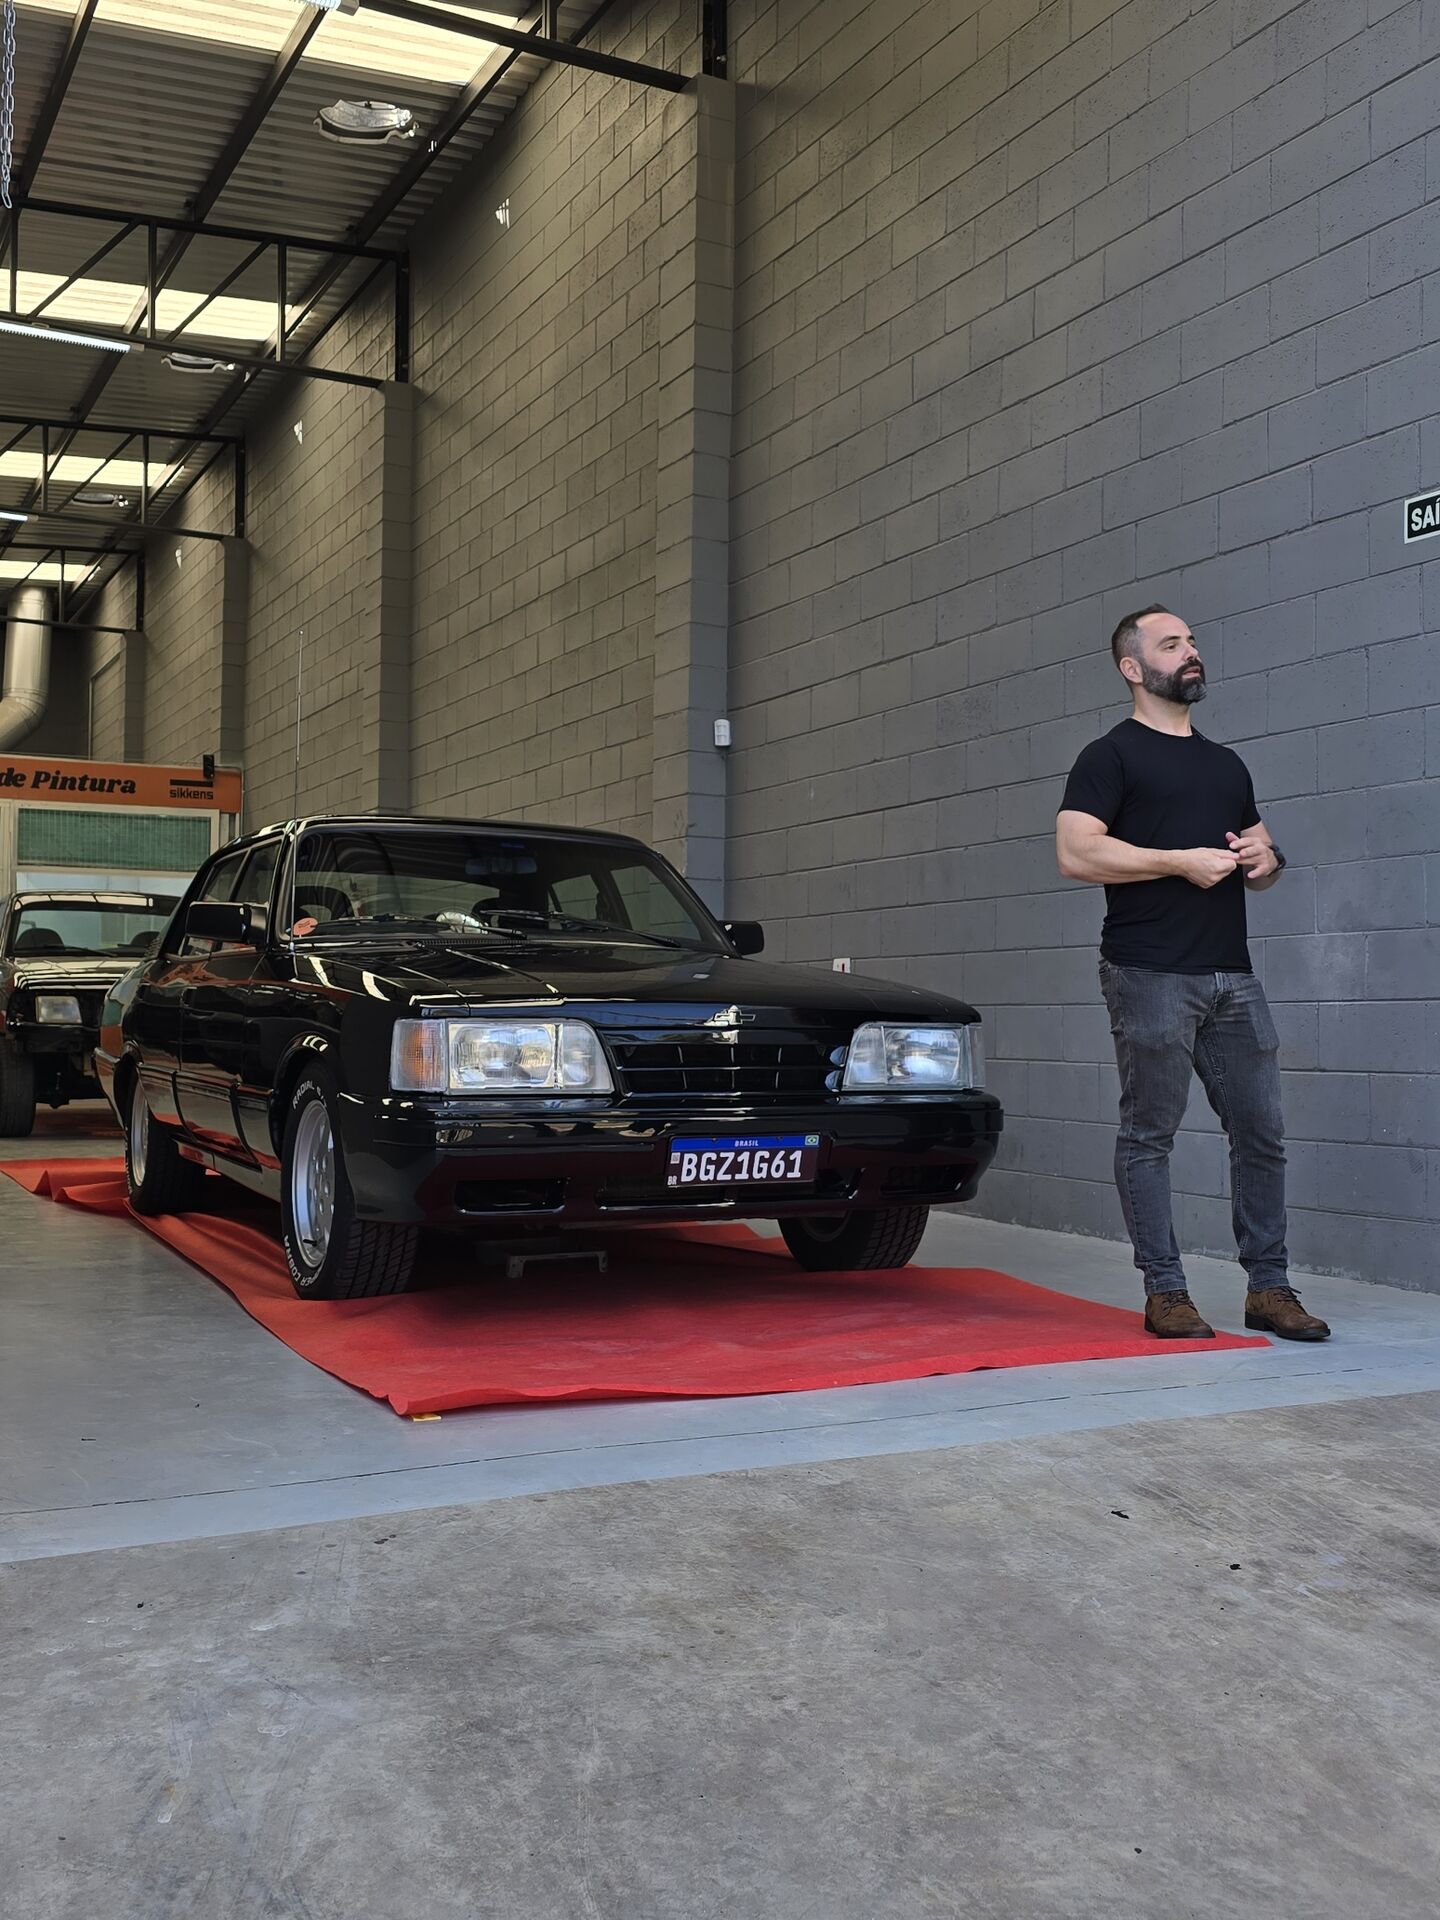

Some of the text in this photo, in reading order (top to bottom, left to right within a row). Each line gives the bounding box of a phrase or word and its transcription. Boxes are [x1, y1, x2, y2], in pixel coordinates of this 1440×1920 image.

[0, 767, 136, 794] de Pintura
[169, 787, 213, 800] sikkens
[292, 1080, 315, 1110] RADIAL
[734, 1139, 759, 1147] BRASIL
[681, 1150, 802, 1182] BGZ1G61
[667, 1175, 678, 1186] BR
